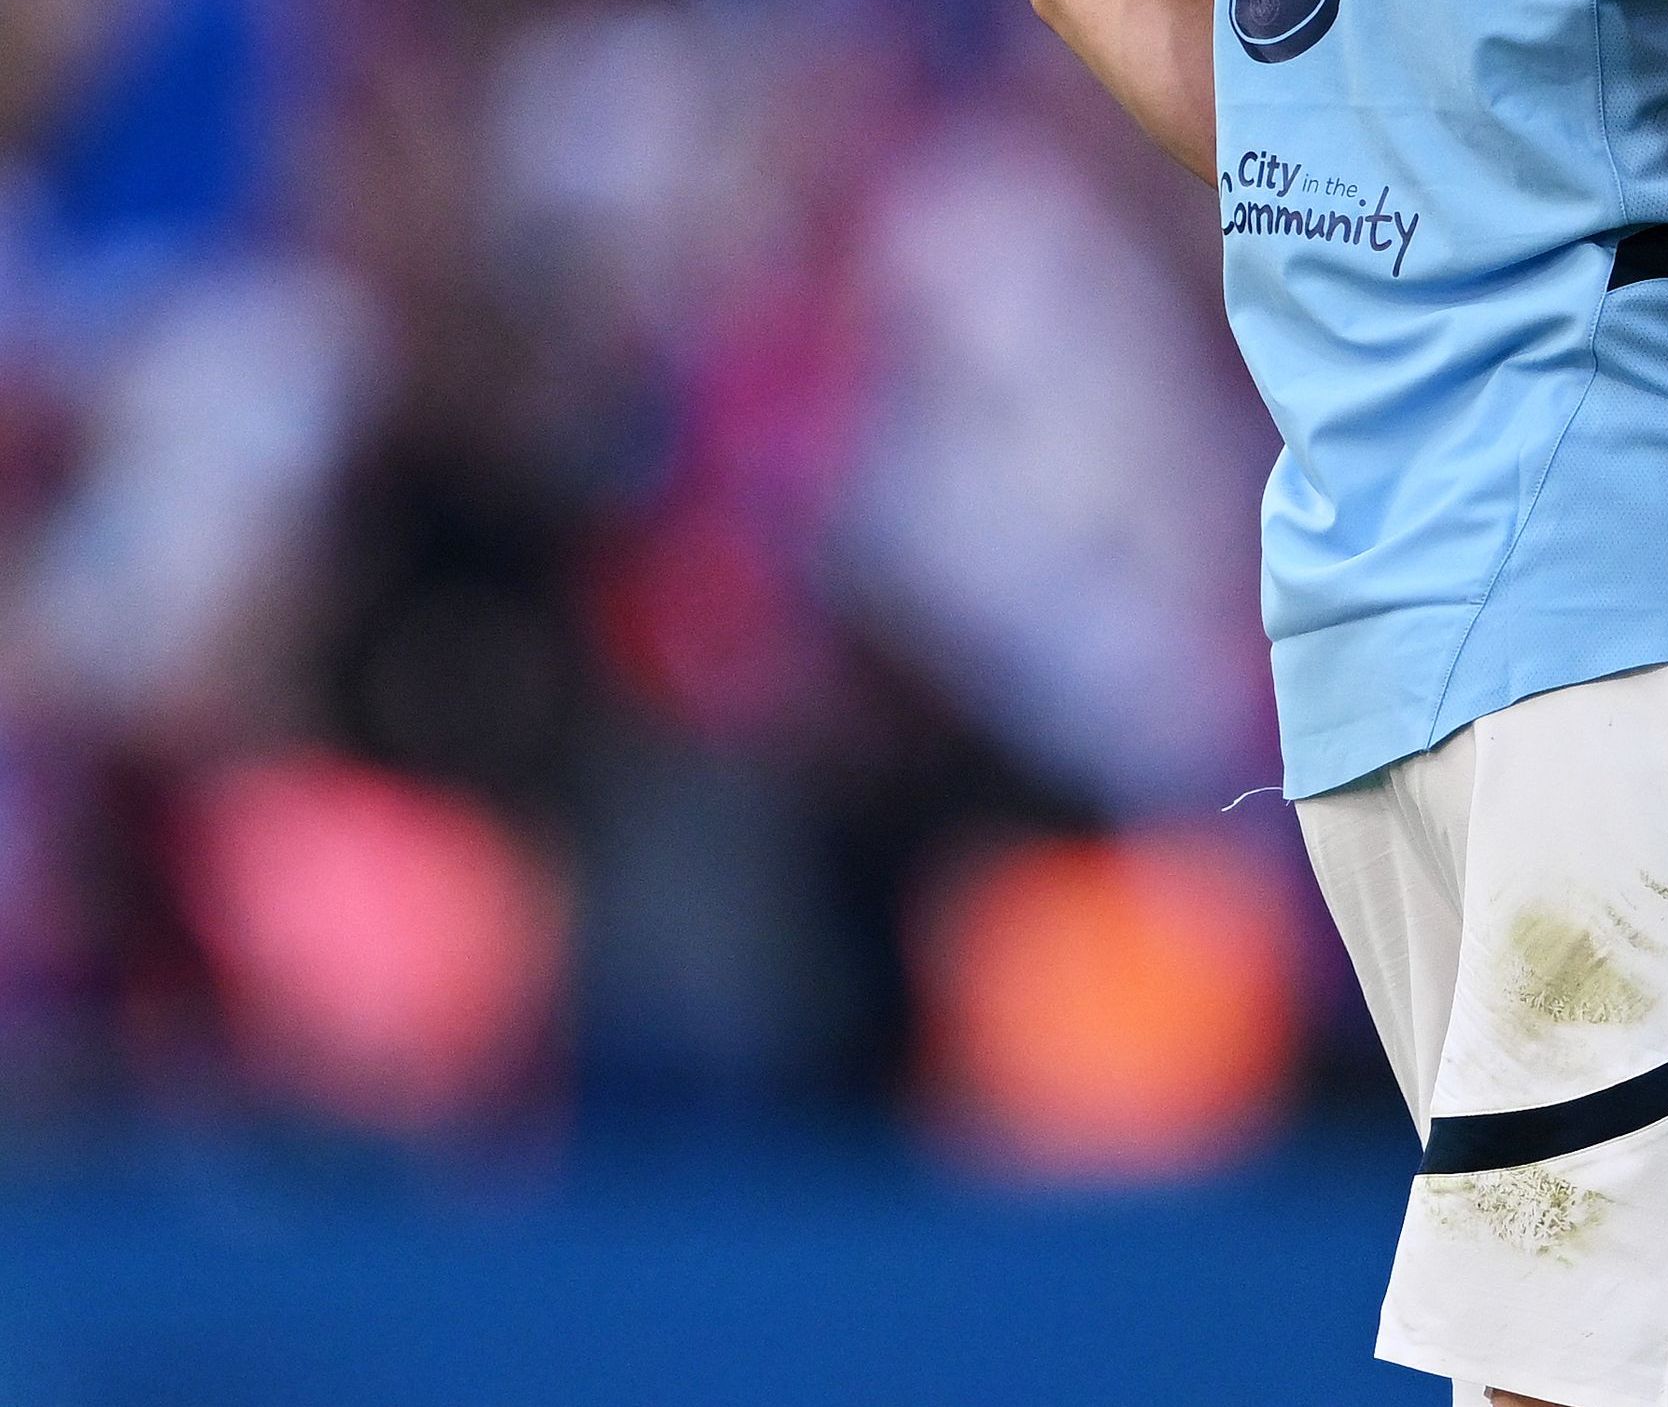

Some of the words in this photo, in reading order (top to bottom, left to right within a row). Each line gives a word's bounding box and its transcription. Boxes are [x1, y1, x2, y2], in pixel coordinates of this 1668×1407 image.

[1238, 151, 1301, 197] City
[1302, 173, 1319, 192] in
[1325, 177, 1358, 198] the
